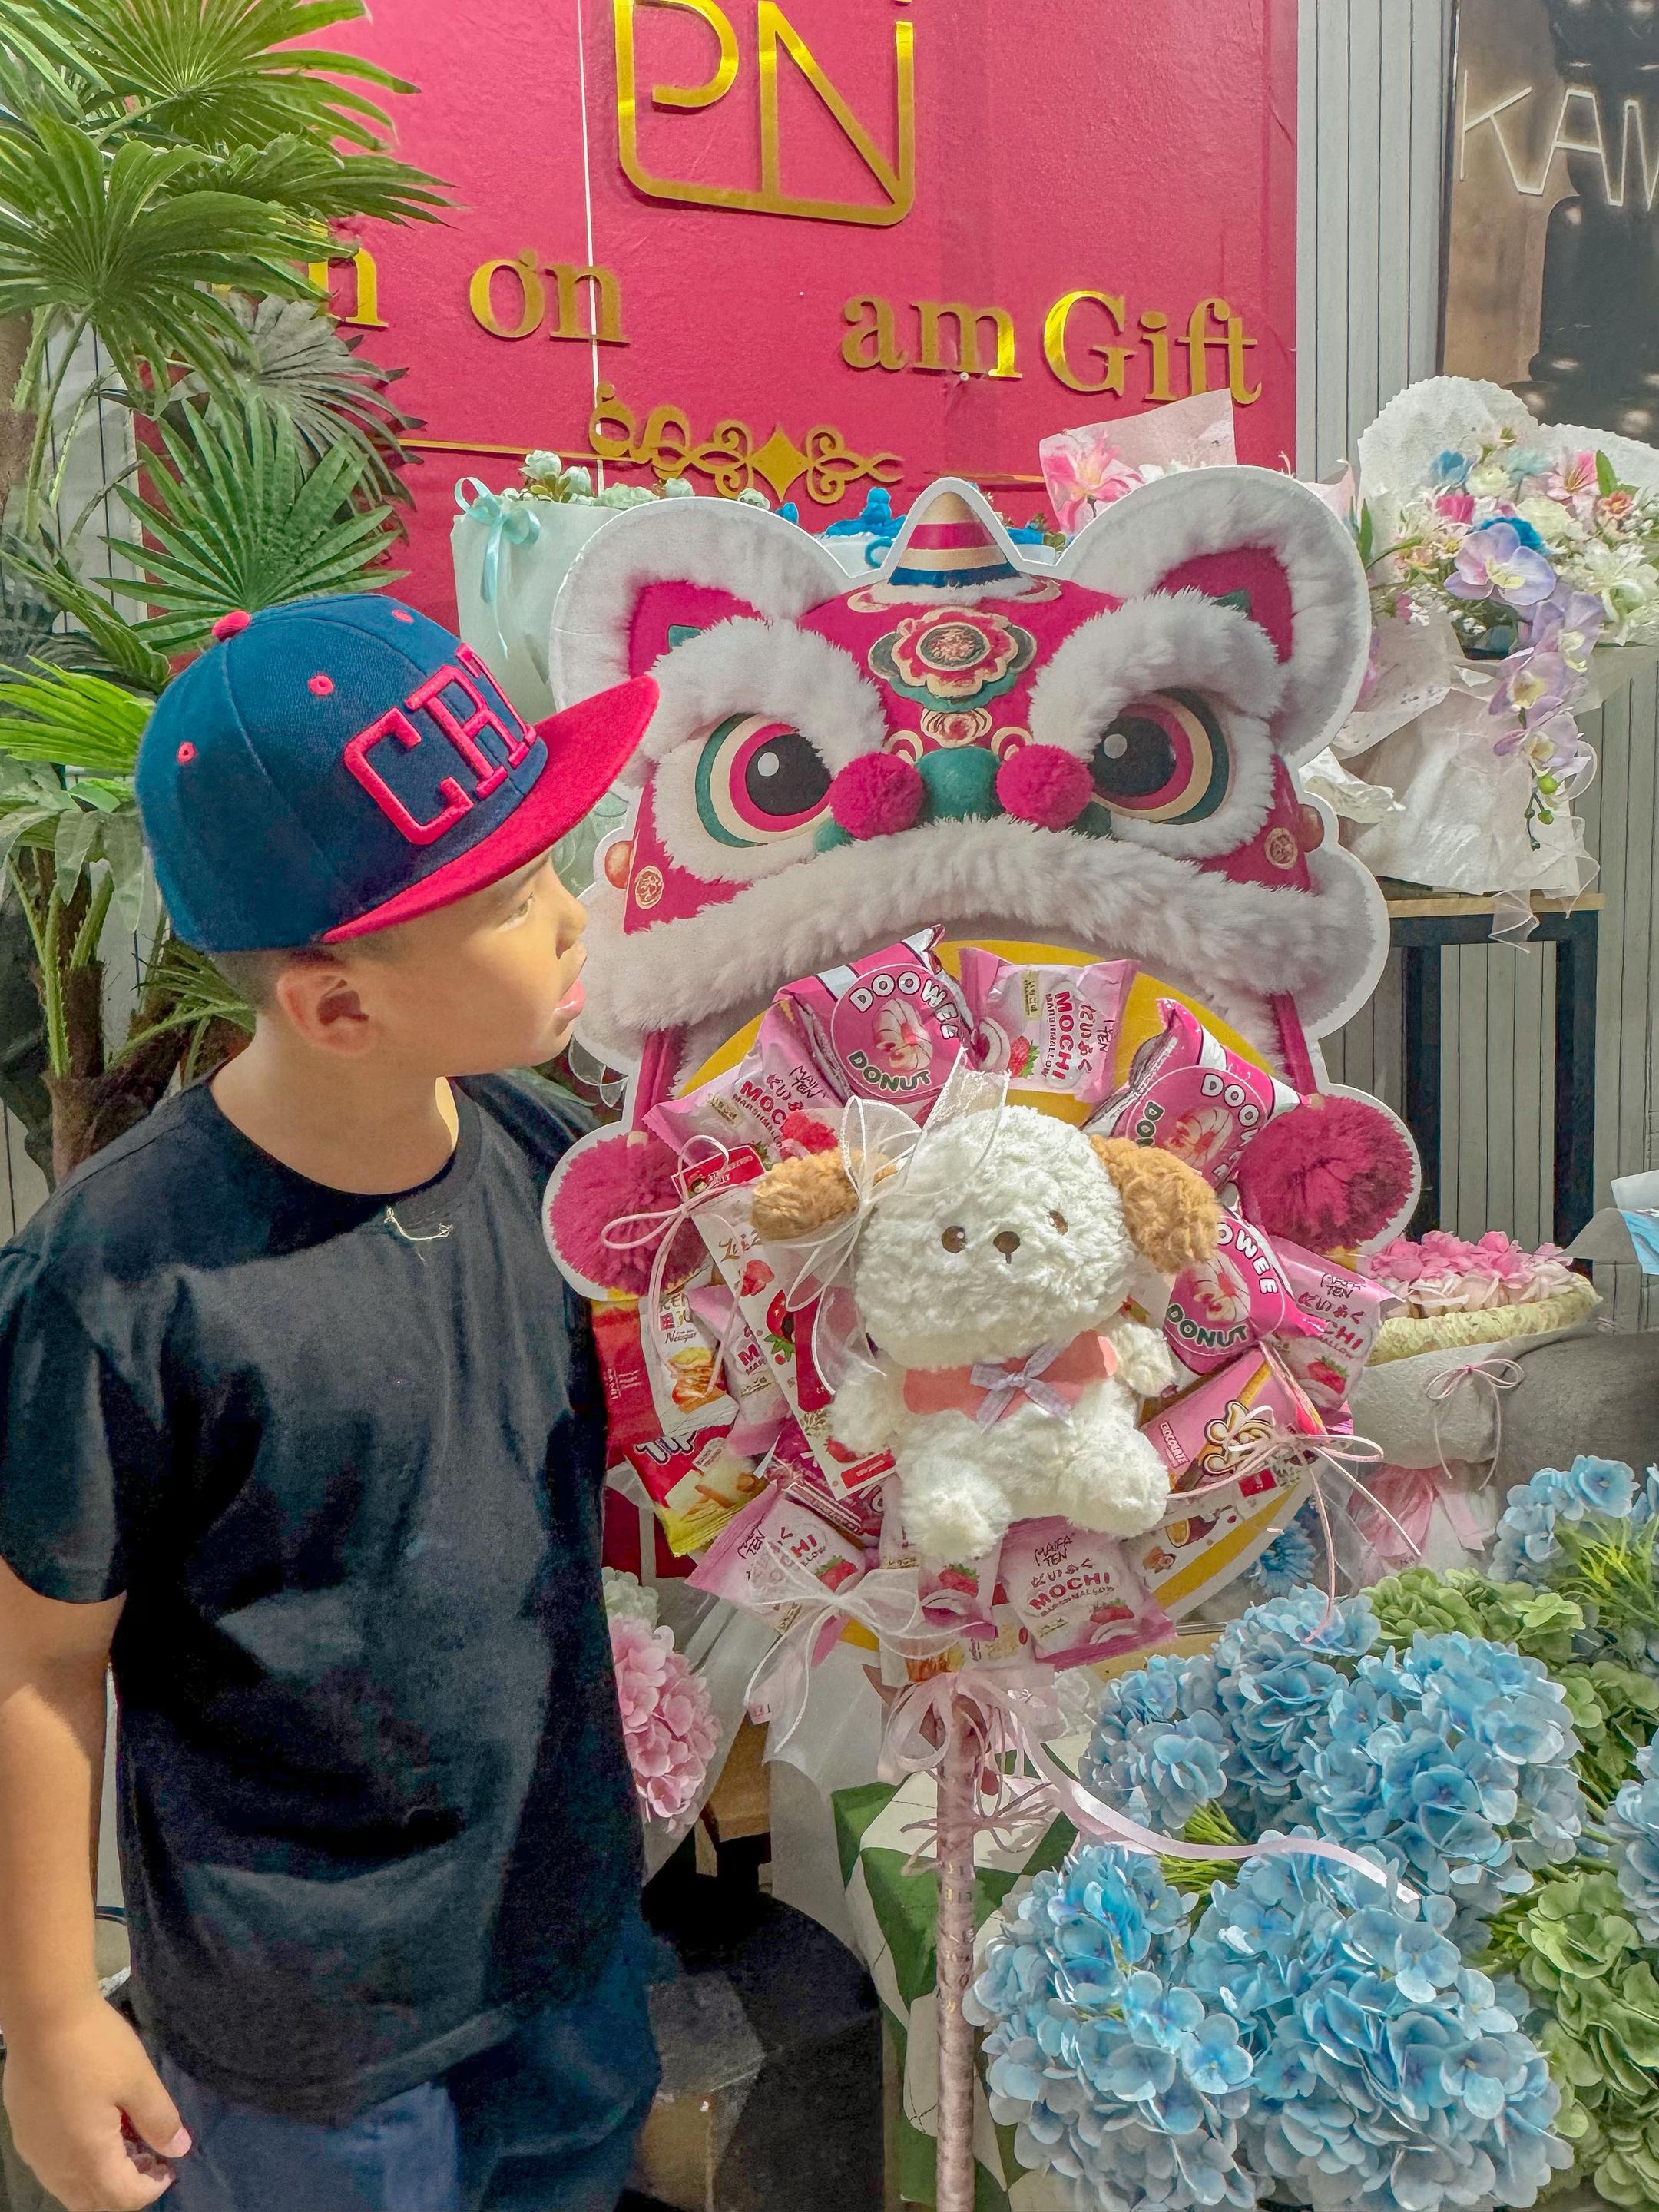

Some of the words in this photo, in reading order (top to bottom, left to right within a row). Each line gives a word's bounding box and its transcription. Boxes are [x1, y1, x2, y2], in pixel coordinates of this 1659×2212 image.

[1043, 290, 1261, 405] Gift
[1041, 993, 1057, 1078] MARSHMALLOW
[1051, 990, 1075, 1080] MOCHI
[846, 1049, 932, 1093] DONUT
[732, 1094, 783, 1149] MARSHMALLO
[740, 1081, 789, 1131] MOC
[1217, 1222, 1278, 1294] OWEE
[1166, 1303, 1248, 1348] DONUT
[1029, 1572, 1111, 1611] MOCHI
